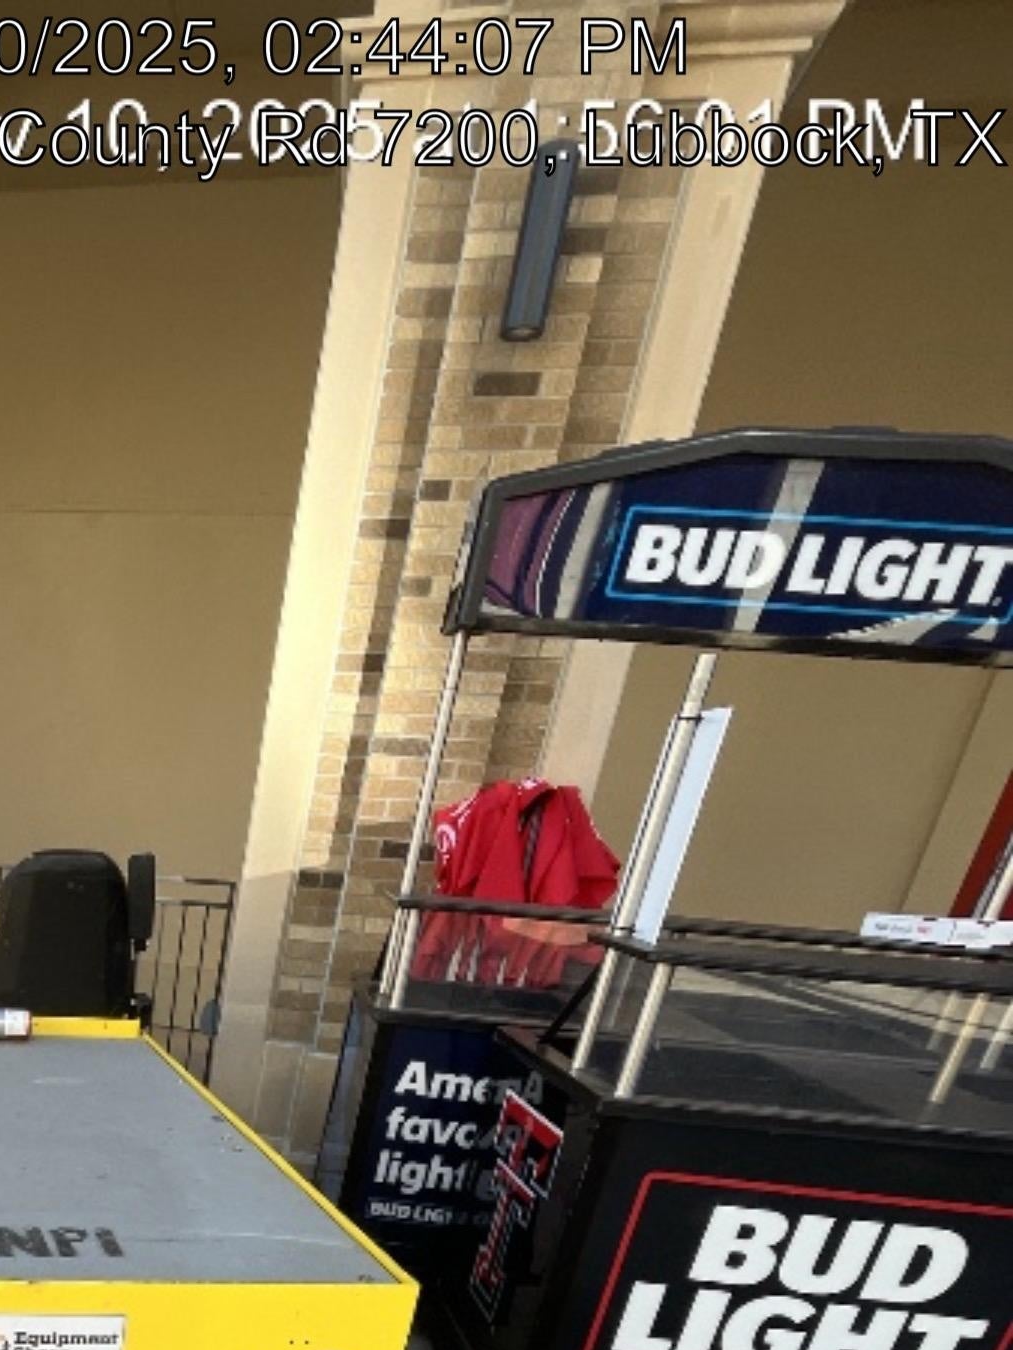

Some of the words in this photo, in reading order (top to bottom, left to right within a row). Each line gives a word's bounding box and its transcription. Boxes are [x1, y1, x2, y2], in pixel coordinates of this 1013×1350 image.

[625, 524, 787, 590] BUD
[785, 533, 1013, 606] LIGHT
[688, 1204, 969, 1303] BUD
[13, 1331, 119, 1347] Equipment
